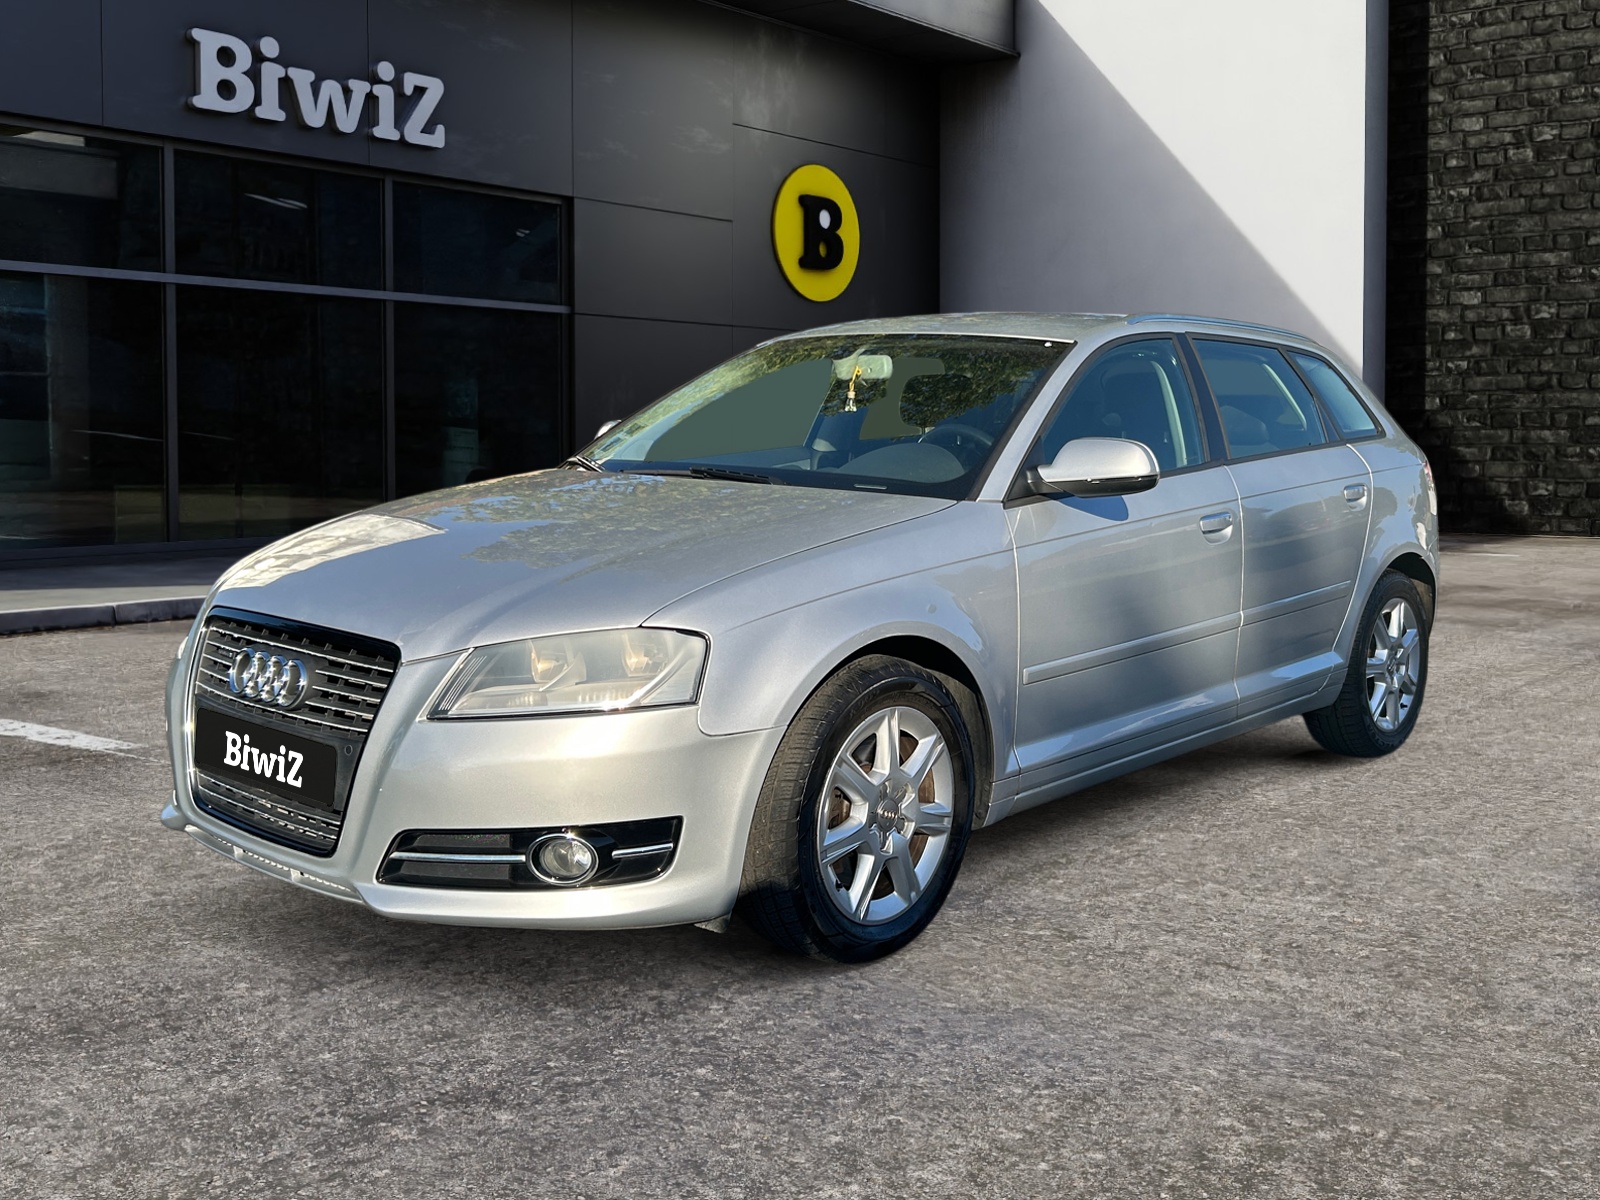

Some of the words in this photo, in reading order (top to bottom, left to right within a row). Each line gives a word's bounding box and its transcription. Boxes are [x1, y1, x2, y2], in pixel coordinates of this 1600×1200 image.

[188, 27, 446, 149] BiwiZ
[798, 194, 844, 271] B
[223, 730, 304, 788] BiwiZ
